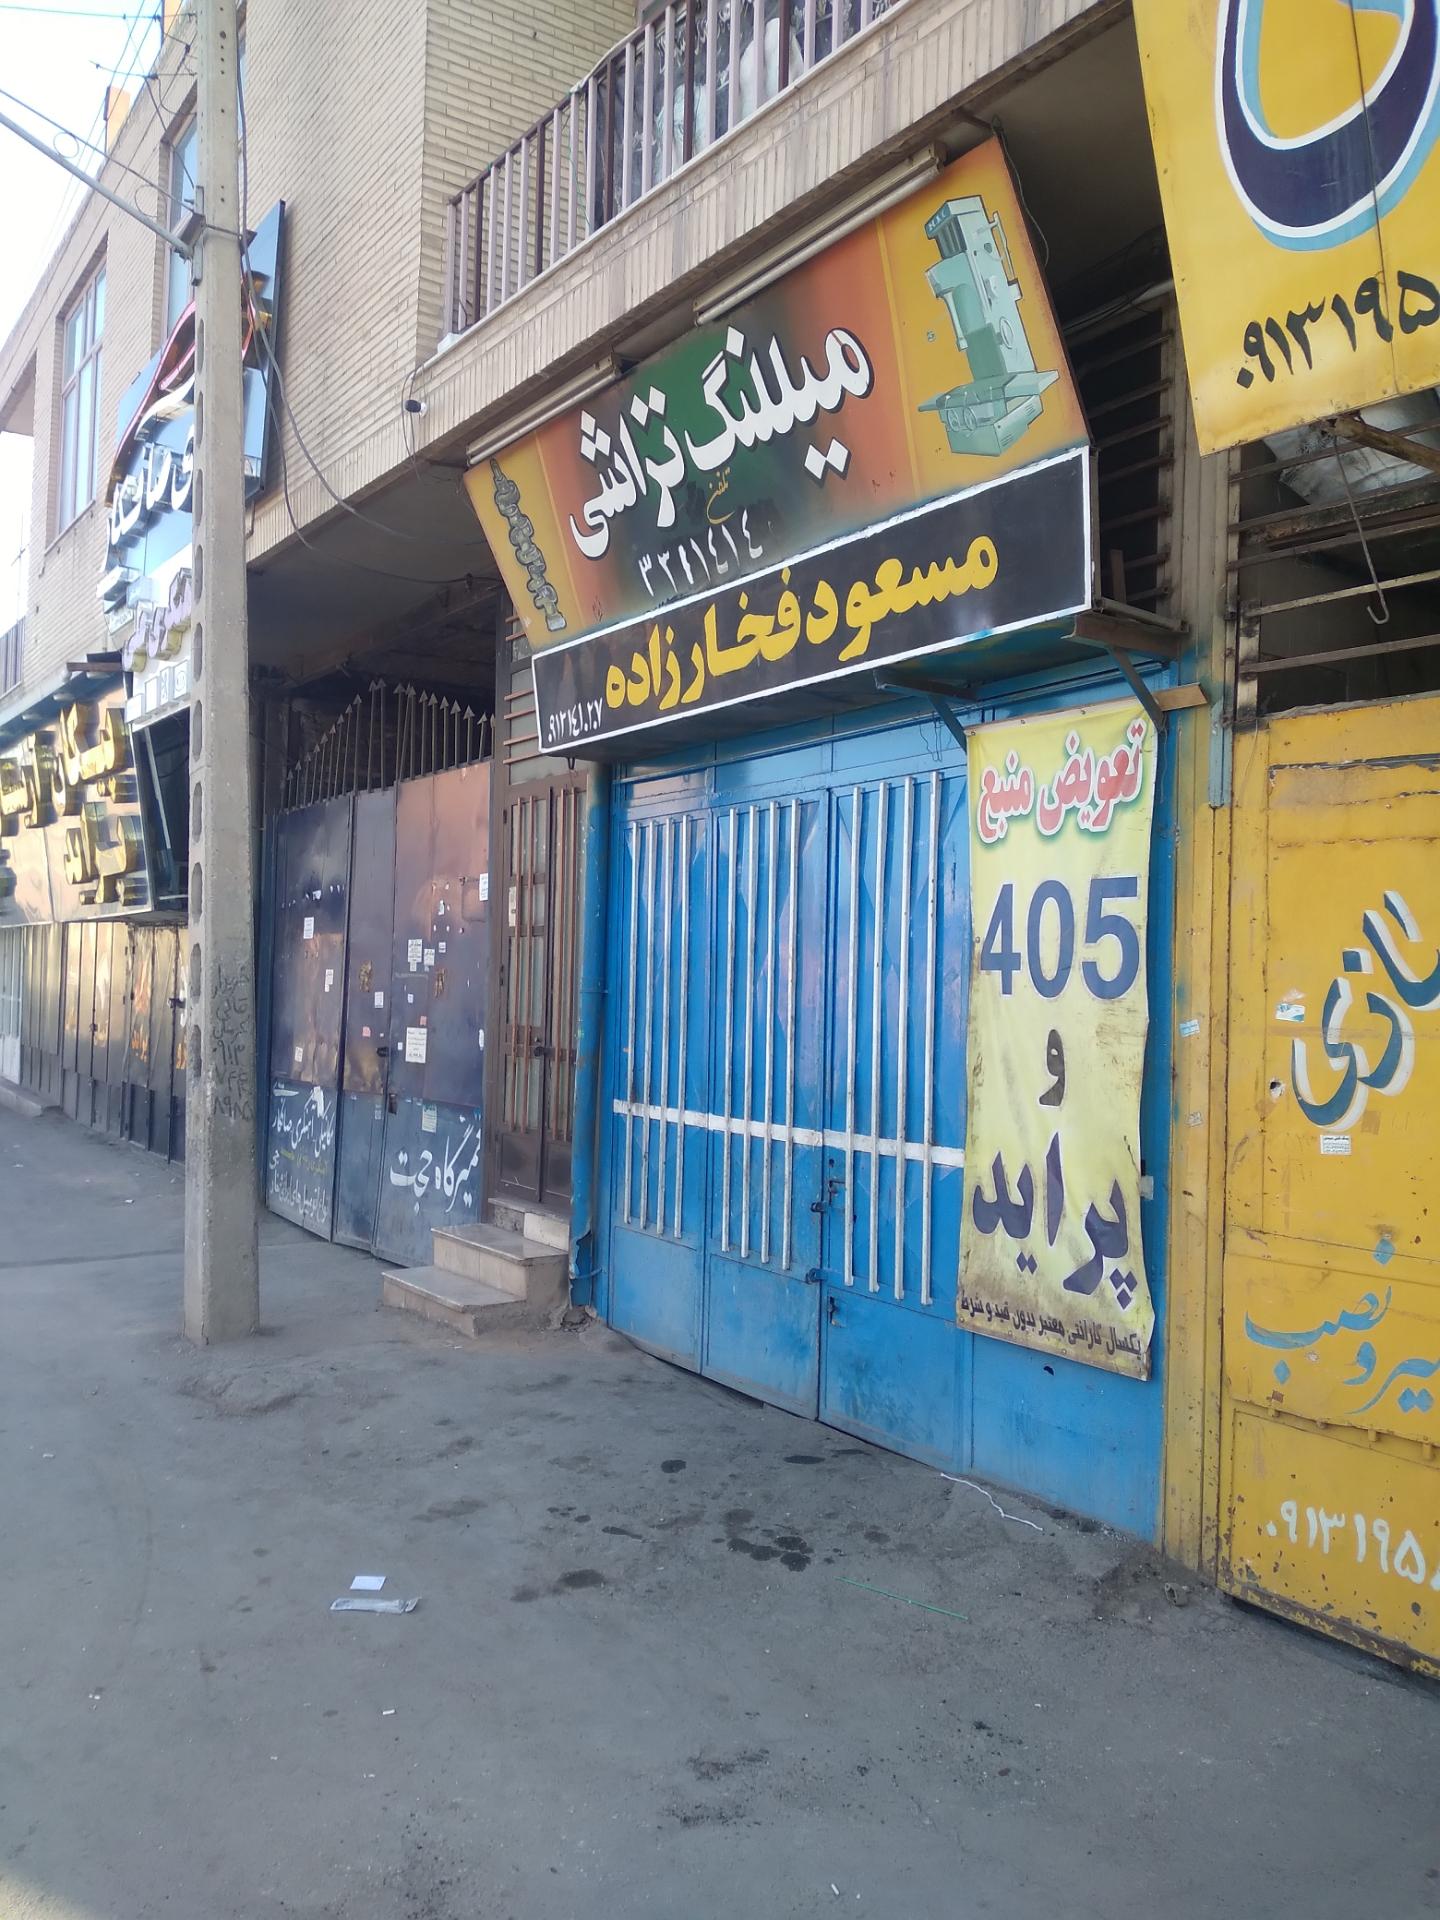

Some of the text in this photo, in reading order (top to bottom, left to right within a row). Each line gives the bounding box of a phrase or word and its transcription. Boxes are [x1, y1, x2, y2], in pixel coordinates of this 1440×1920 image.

[570, 386, 695, 557] تراشی
[706, 466, 736, 525] تلفن
[806, 536, 999, 661] مسعود
[978, 719, 1146, 843] تعویض منبع
[980, 876, 1140, 999] 405
[1039, 1029, 1066, 1107] و
[389, 1148, 433, 1216] حجت
[972, 1131, 1139, 1311] پراید
